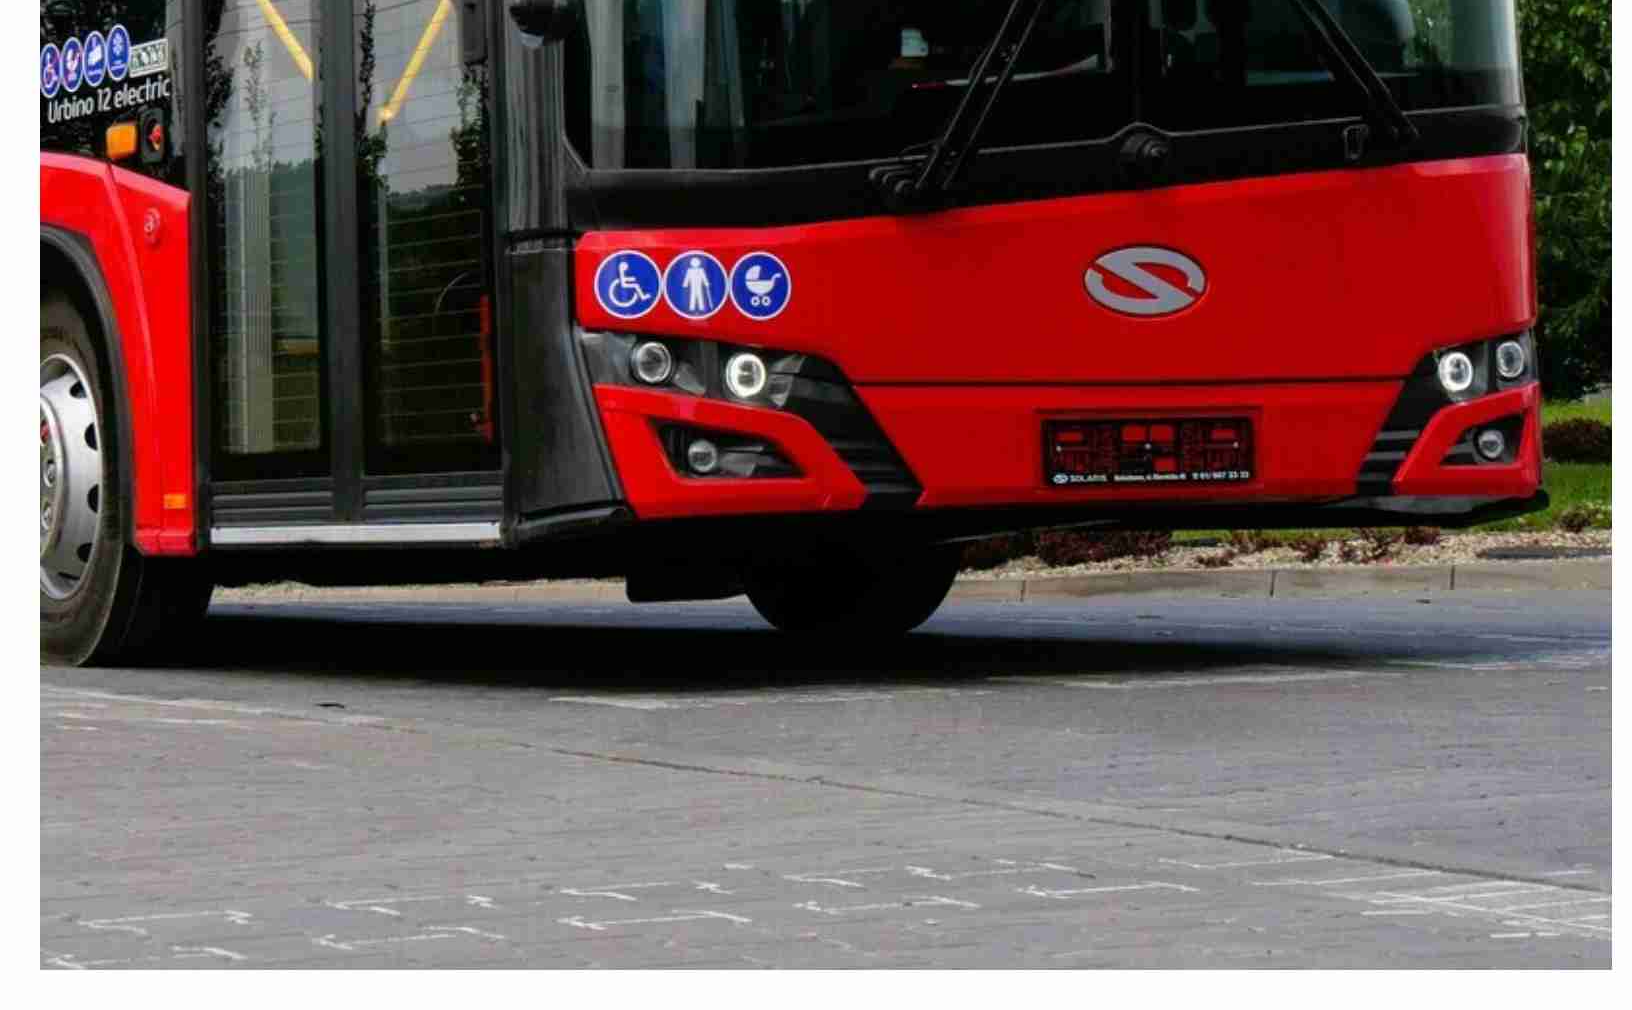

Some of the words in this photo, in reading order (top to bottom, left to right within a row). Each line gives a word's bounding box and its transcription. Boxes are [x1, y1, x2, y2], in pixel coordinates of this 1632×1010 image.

[48, 95, 94, 124] Urbino
[97, 87, 113, 112] 12
[113, 75, 171, 109] electric
